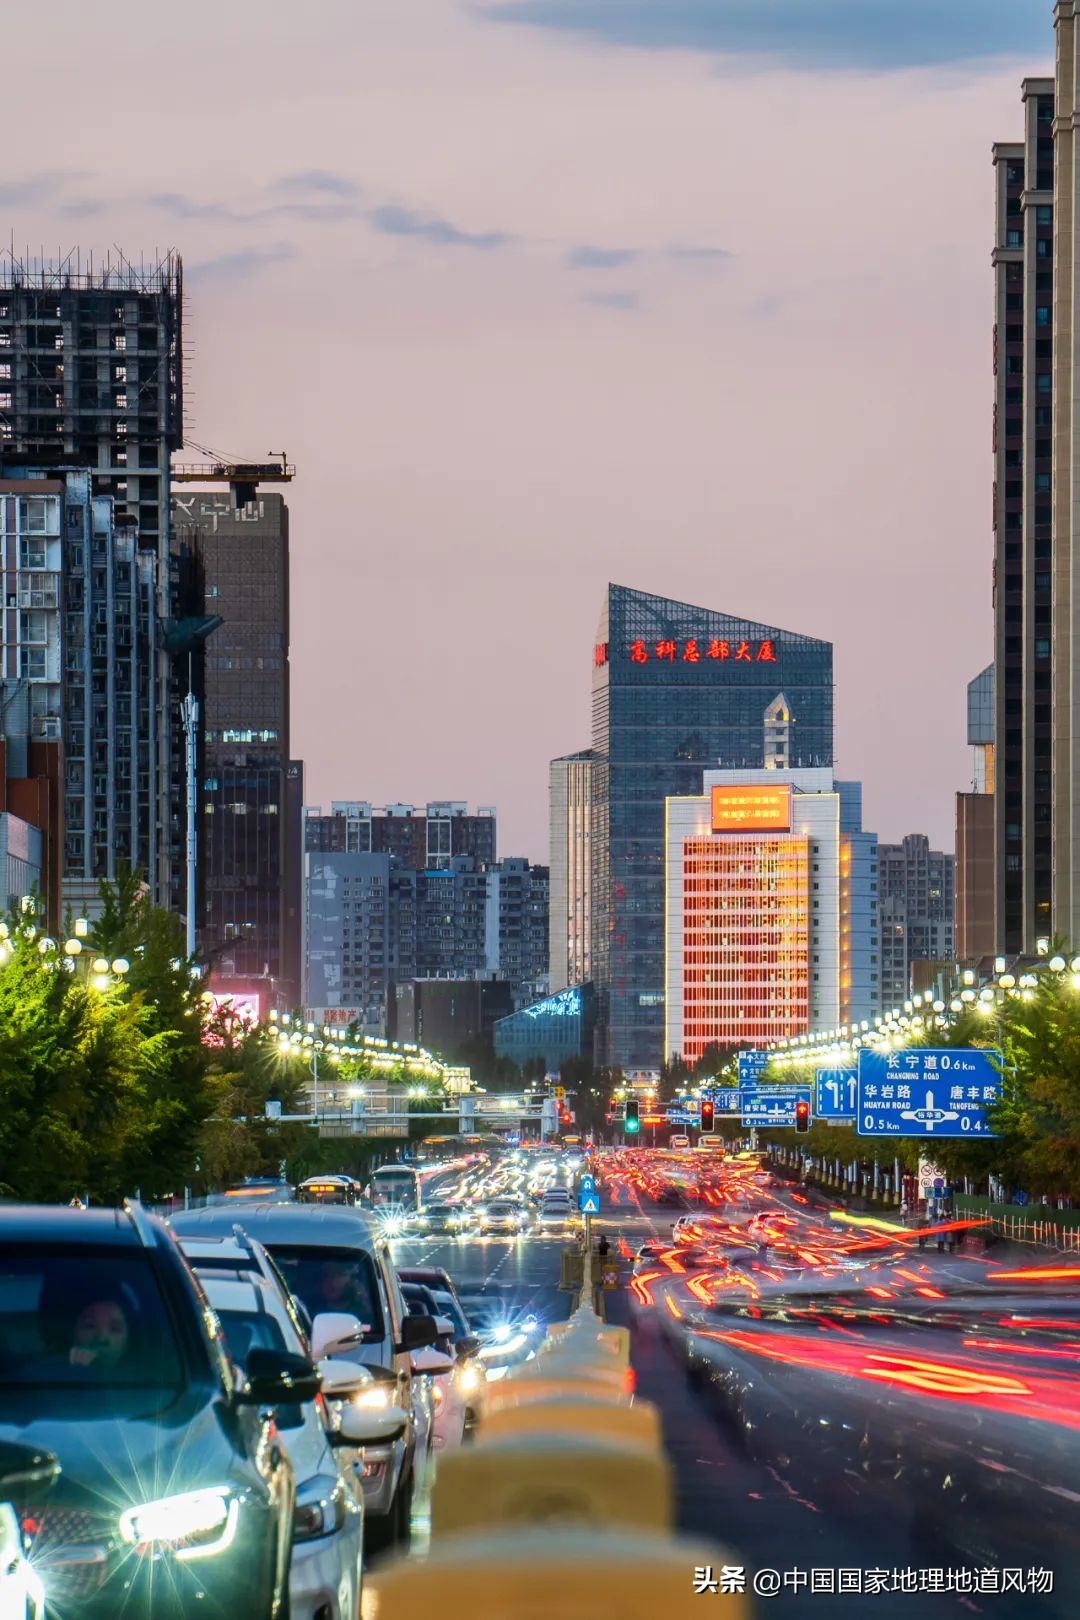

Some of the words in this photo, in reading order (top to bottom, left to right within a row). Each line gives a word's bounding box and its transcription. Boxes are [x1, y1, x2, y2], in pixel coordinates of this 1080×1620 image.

[629, 639, 777, 663] 高科总部大厦
[887, 1055, 937, 1070] 长宁道
[864, 1084, 911, 1099] 华岩路
[950, 1086, 997, 1100] 唐丰路
[892, 1102, 911, 1110] ROAD
